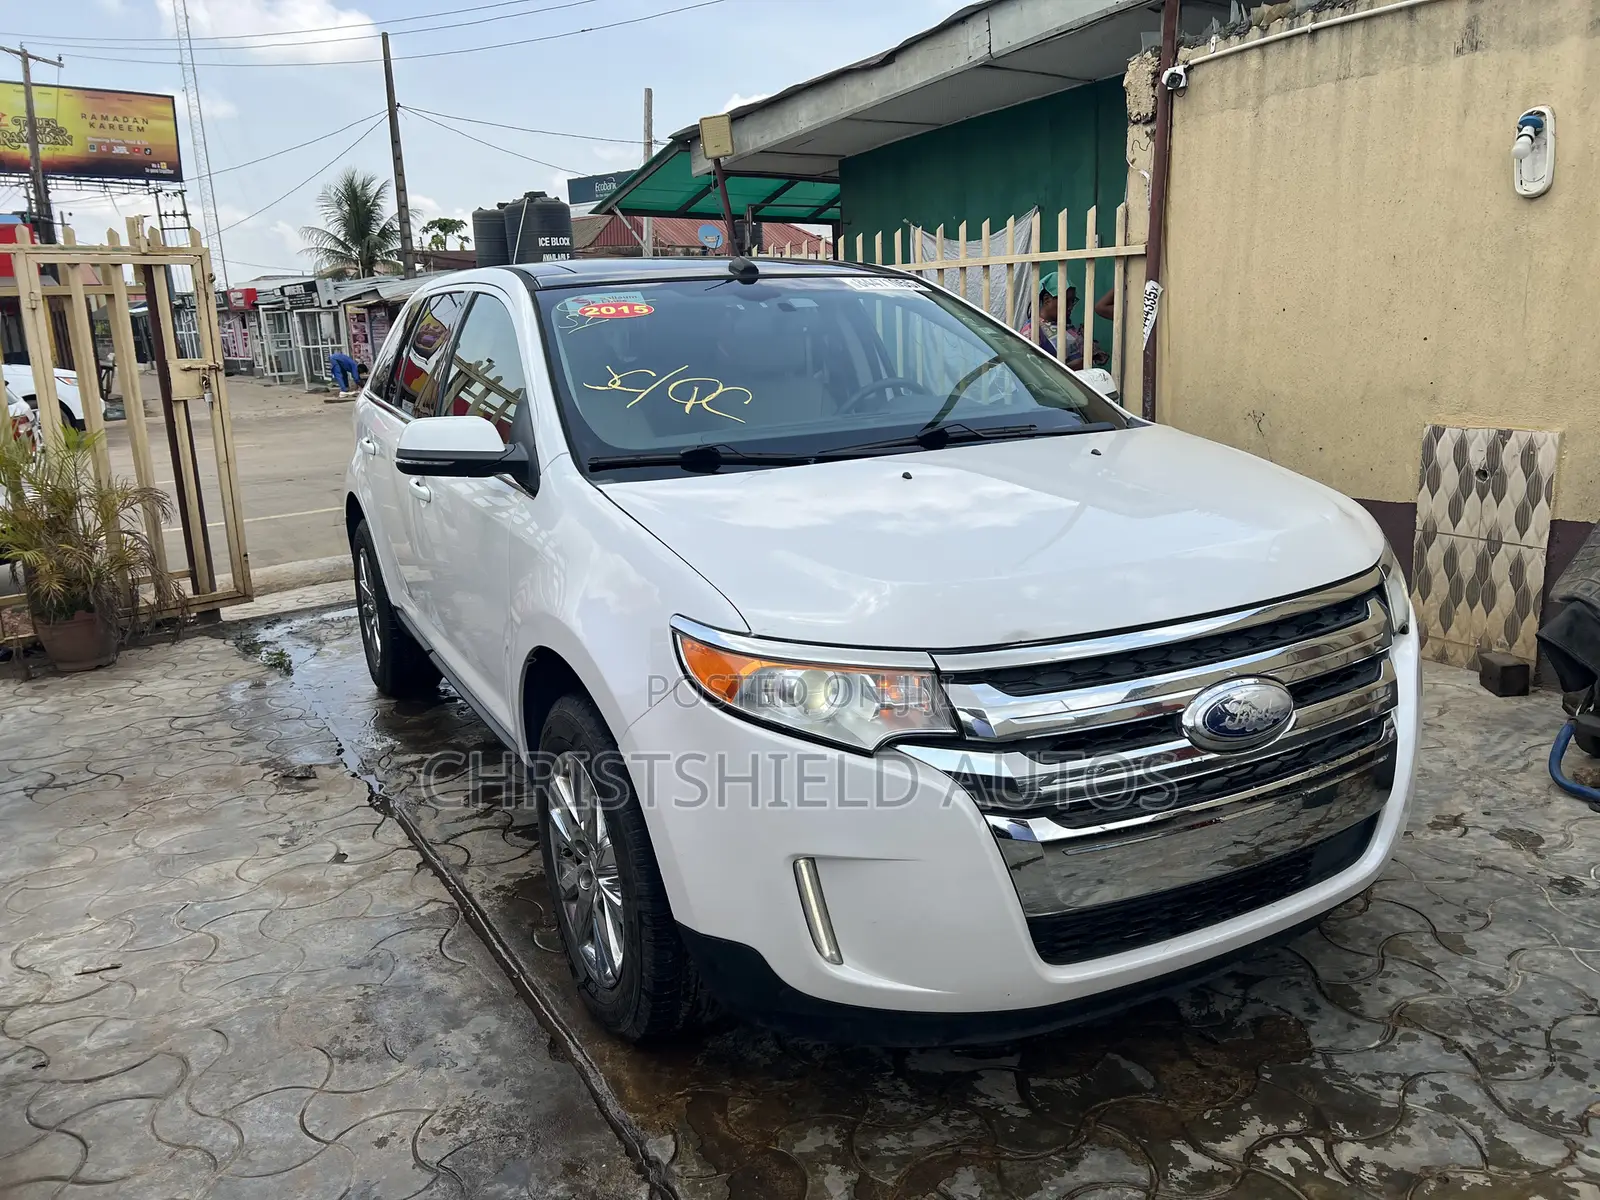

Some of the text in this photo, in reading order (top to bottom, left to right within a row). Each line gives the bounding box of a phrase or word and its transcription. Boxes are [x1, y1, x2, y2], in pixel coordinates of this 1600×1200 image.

[11, 116, 58, 131] TLES
[81, 113, 149, 125] RAMADAN
[89, 122, 145, 133] KAREEM
[595, 181, 617, 192] Ecobank
[538, 236, 570, 247] ICE BLOCK
[584, 305, 649, 315] 2015
